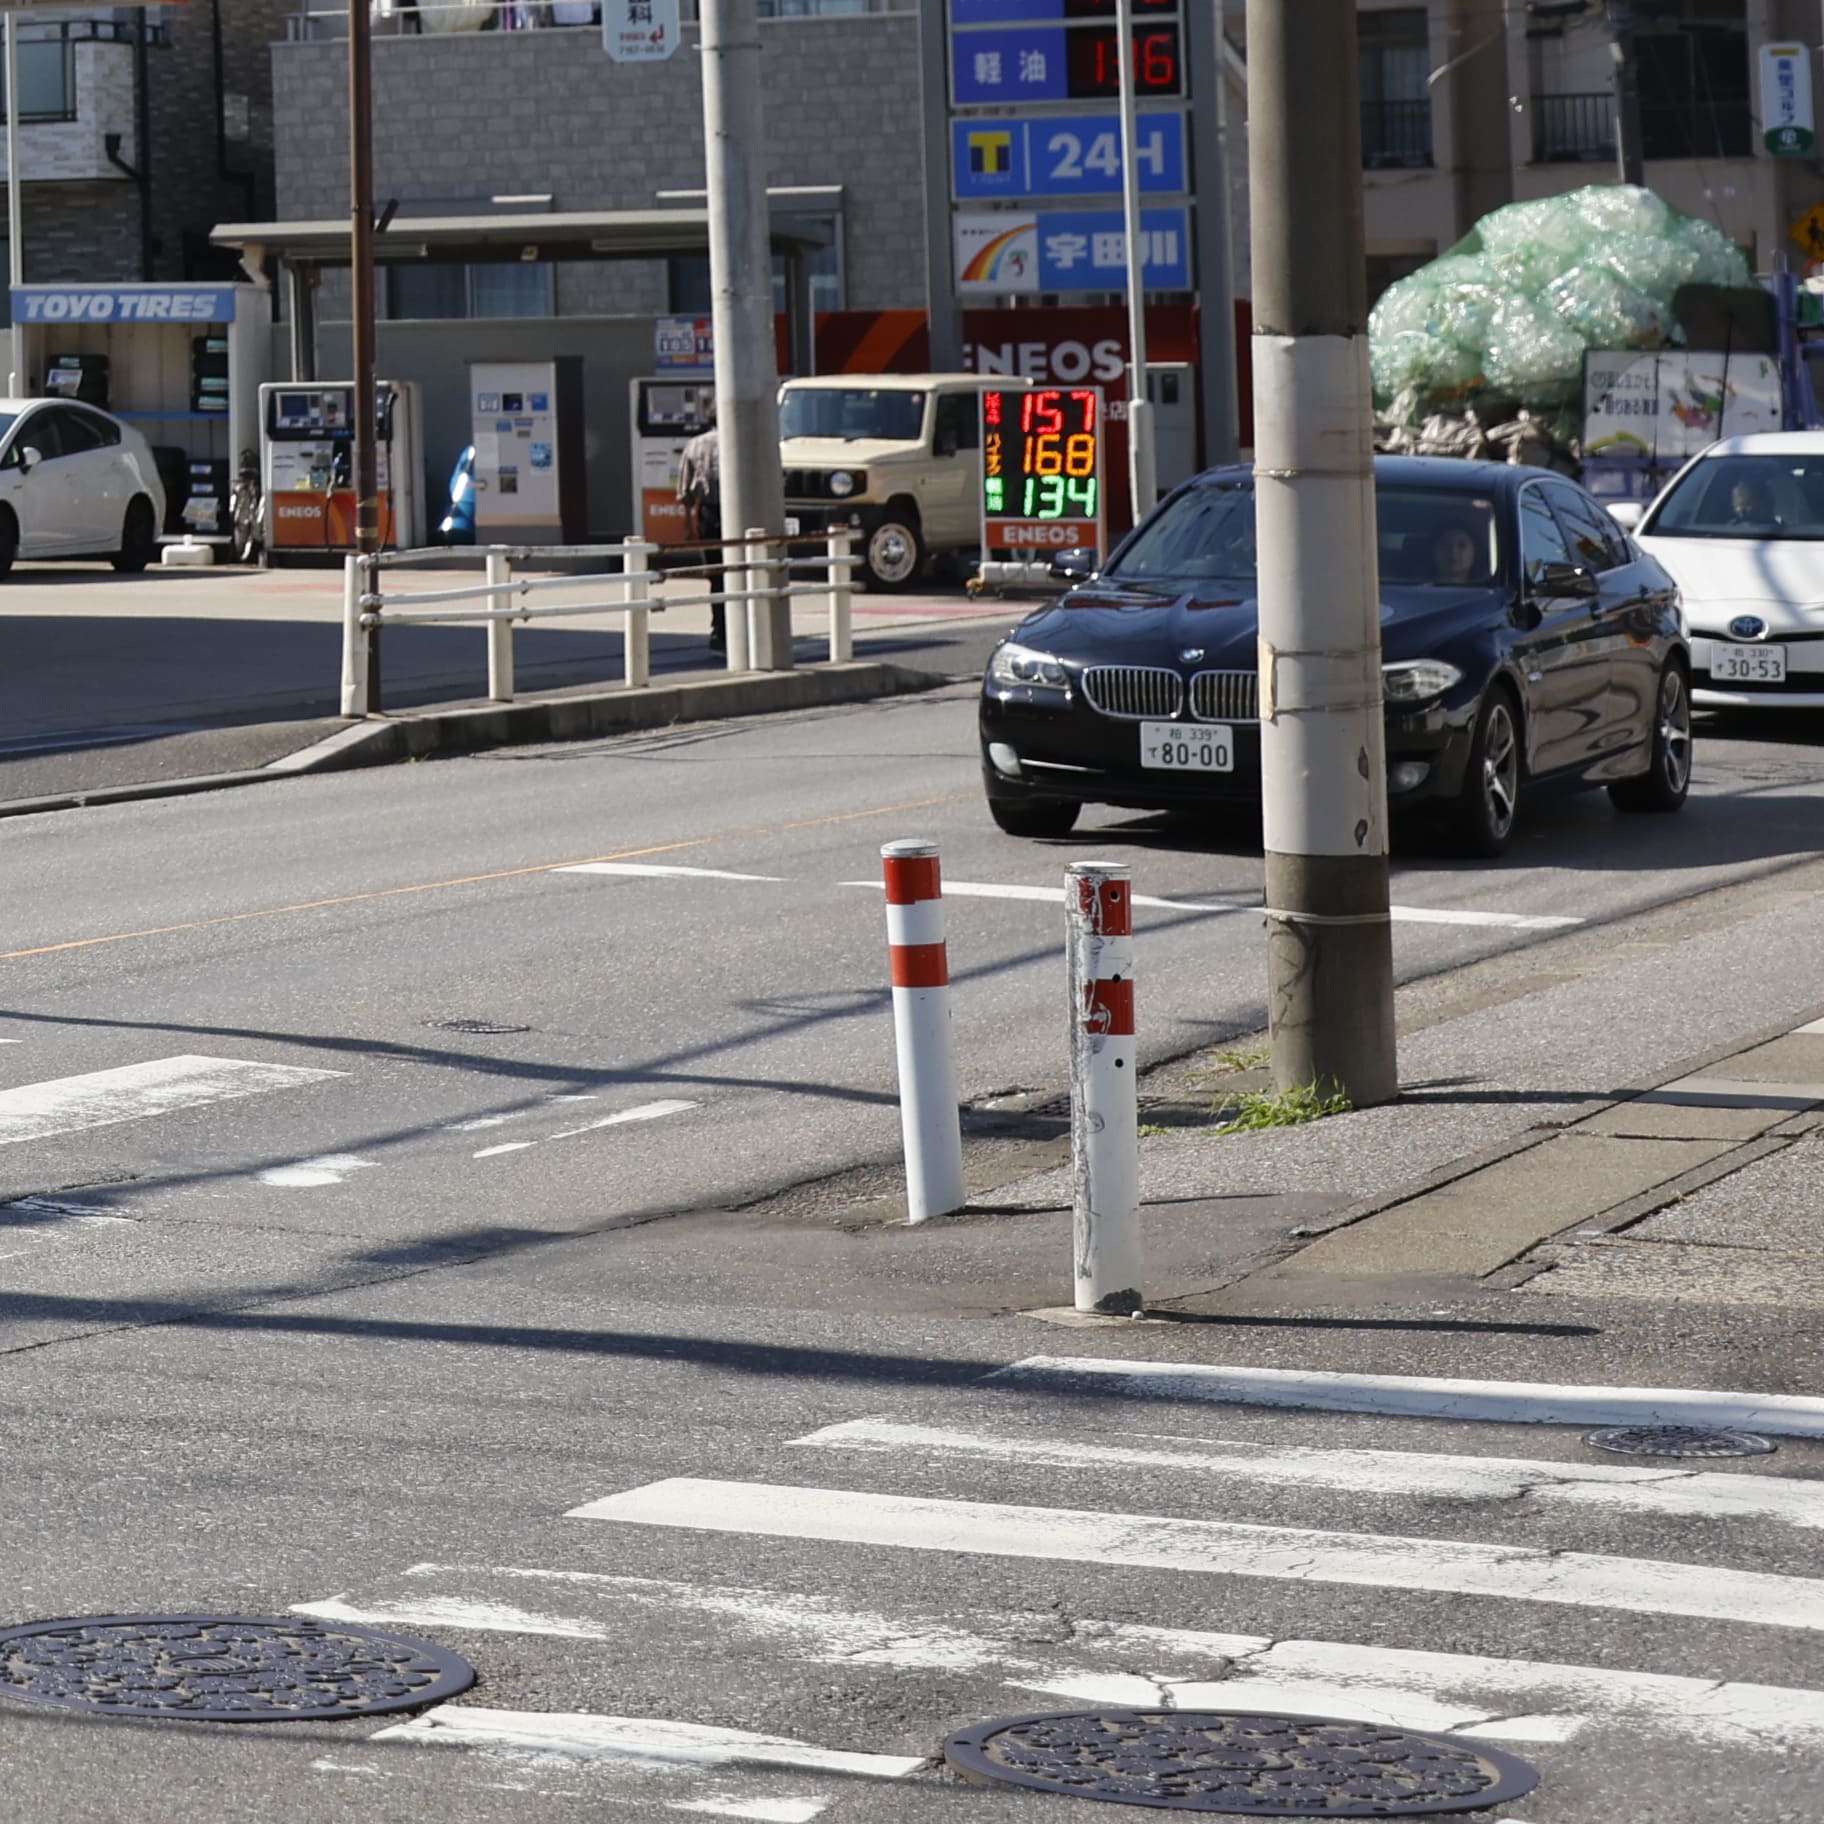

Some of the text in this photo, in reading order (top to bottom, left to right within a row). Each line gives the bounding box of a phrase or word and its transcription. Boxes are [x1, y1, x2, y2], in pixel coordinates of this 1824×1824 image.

[974, 50, 1047, 85] 軽油
[1048, 131, 1164, 180] 24H
[1046, 230, 1178, 269] 宇田川
[25, 294, 217, 319] TOYO TIRES
[1021, 389, 1096, 434] 157
[1023, 433, 1096, 476] 168
[278, 506, 322, 519] ENEOS
[1023, 475, 1097, 520] 134
[1003, 526, 1079, 544] ENEOS
[1727, 658, 1781, 678] 30-53
[1162, 742, 1228, 767] 80-00
